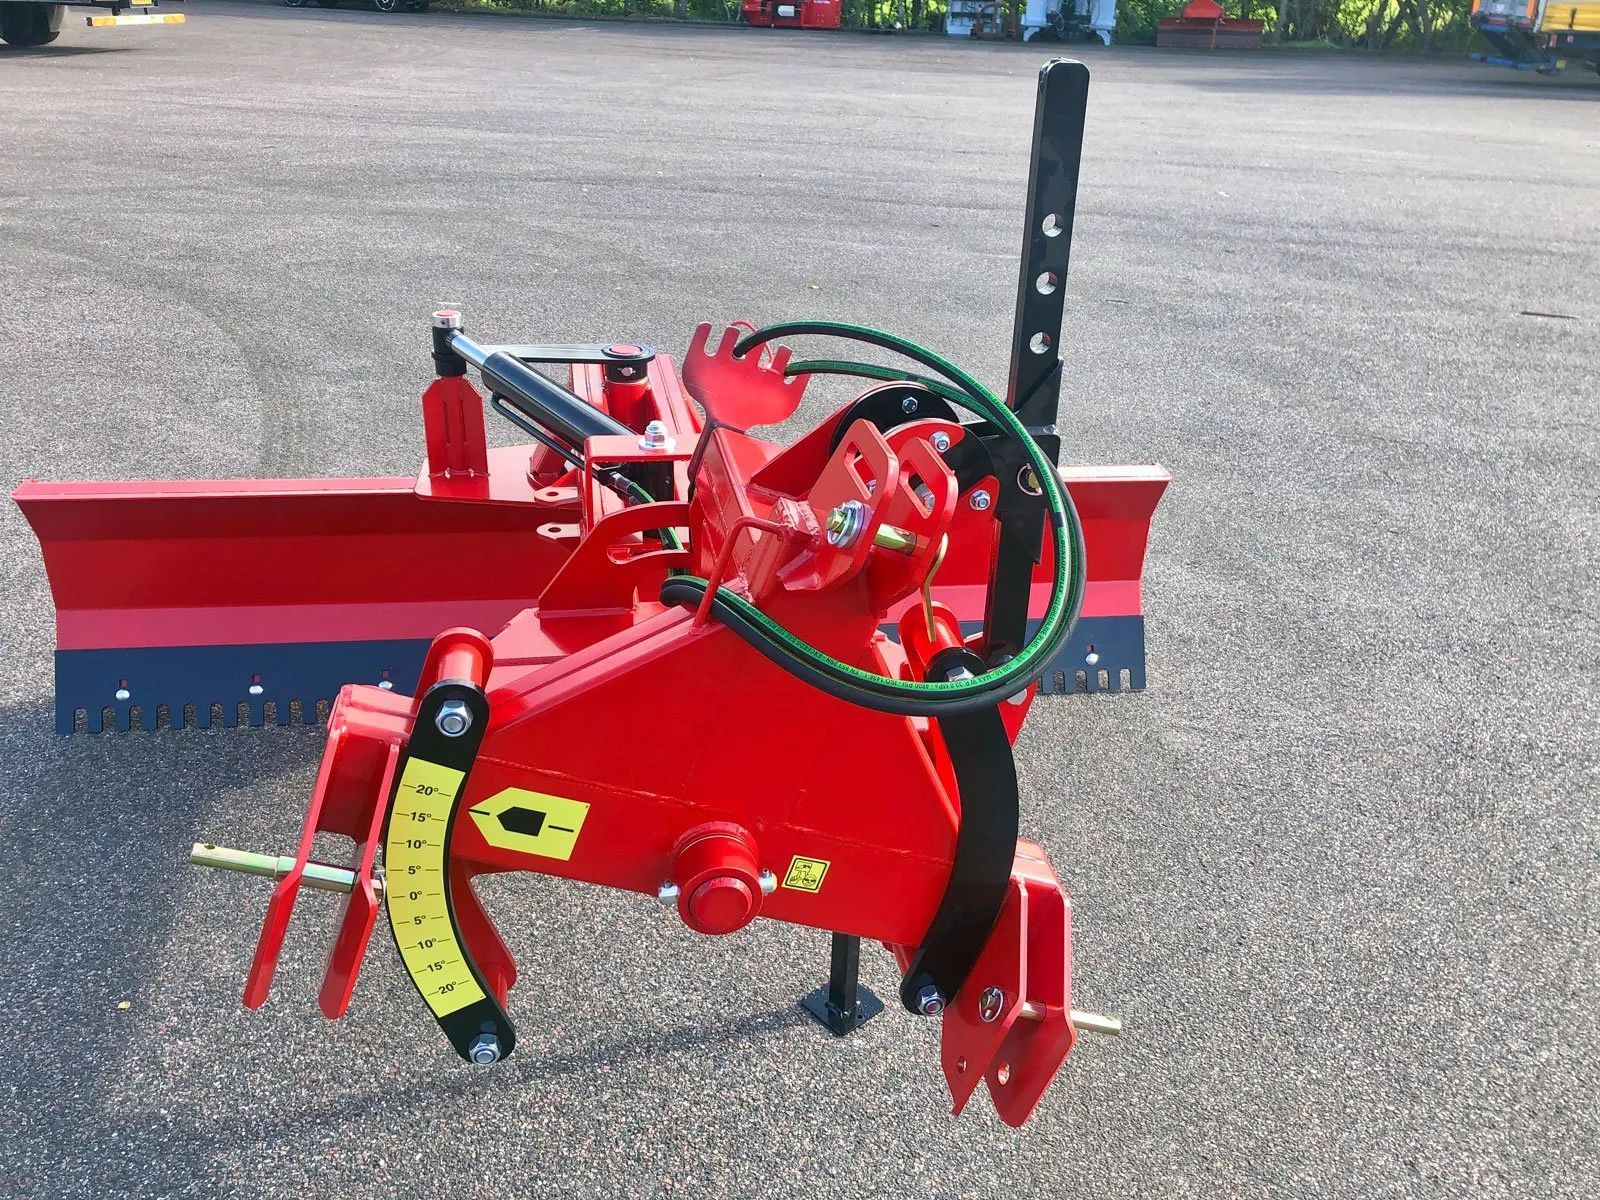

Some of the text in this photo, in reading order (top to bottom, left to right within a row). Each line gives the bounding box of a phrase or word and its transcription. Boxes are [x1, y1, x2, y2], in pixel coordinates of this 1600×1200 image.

[1039, 605, 1059, 637] GREENLINE
[1030, 633, 1044, 649] PLUS
[976, 673, 991, 684] MAX
[415, 784, 439, 797] 20°
[410, 811, 432, 823] 15°
[405, 839, 427, 850] 10°
[408, 865, 421, 875] 5°
[409, 890, 422, 901] 0°
[413, 915, 427, 926] 5°
[417, 938, 437, 951] 10°
[426, 960, 446, 973] 15°
[438, 981, 457, 996] 20°
